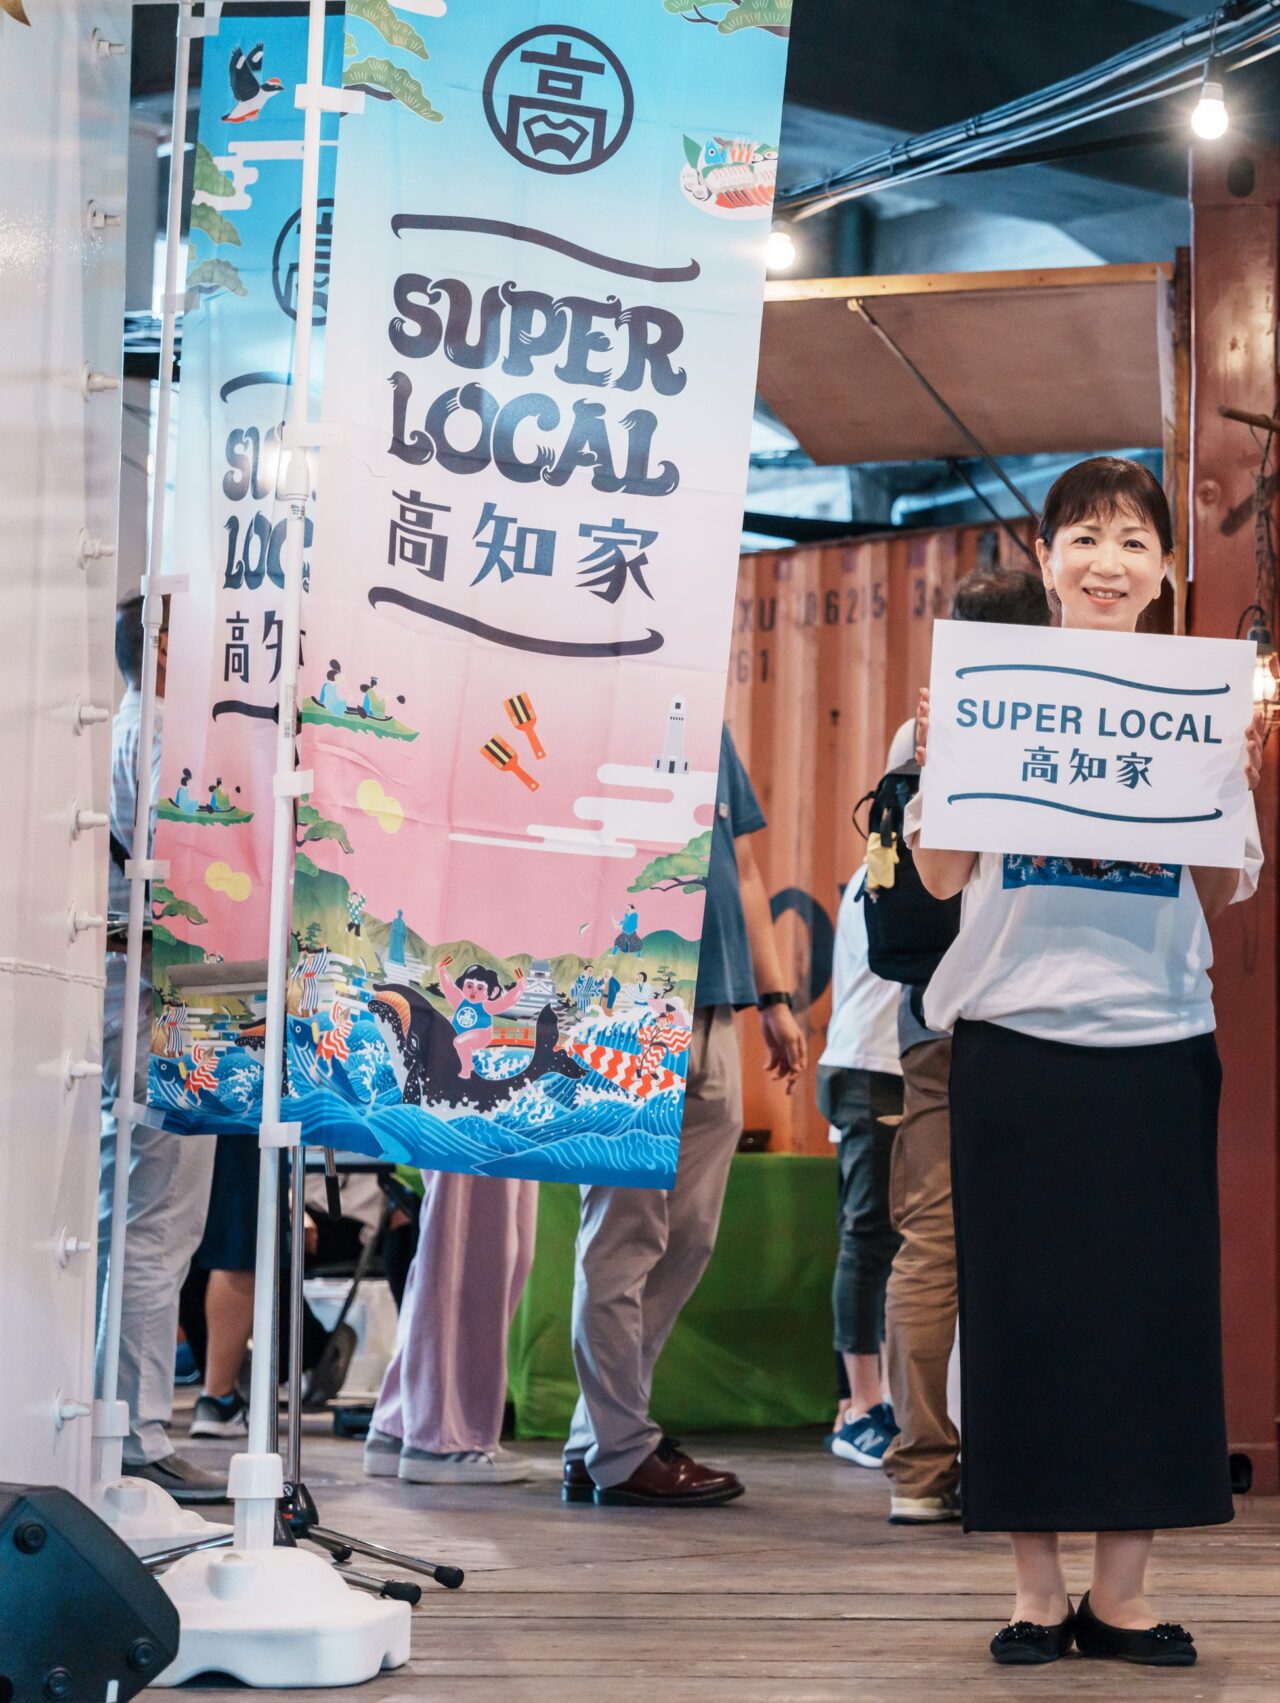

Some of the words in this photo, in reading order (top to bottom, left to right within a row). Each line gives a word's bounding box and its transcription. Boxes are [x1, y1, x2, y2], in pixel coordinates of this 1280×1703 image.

[388, 273, 687, 396] SUPER
[387, 371, 680, 497] LOCAL
[387, 489, 660, 604] 高知家
[956, 698, 1083, 735] SUPER
[1098, 707, 1223, 745] LOCAL
[1021, 745, 1153, 789] 高知家
